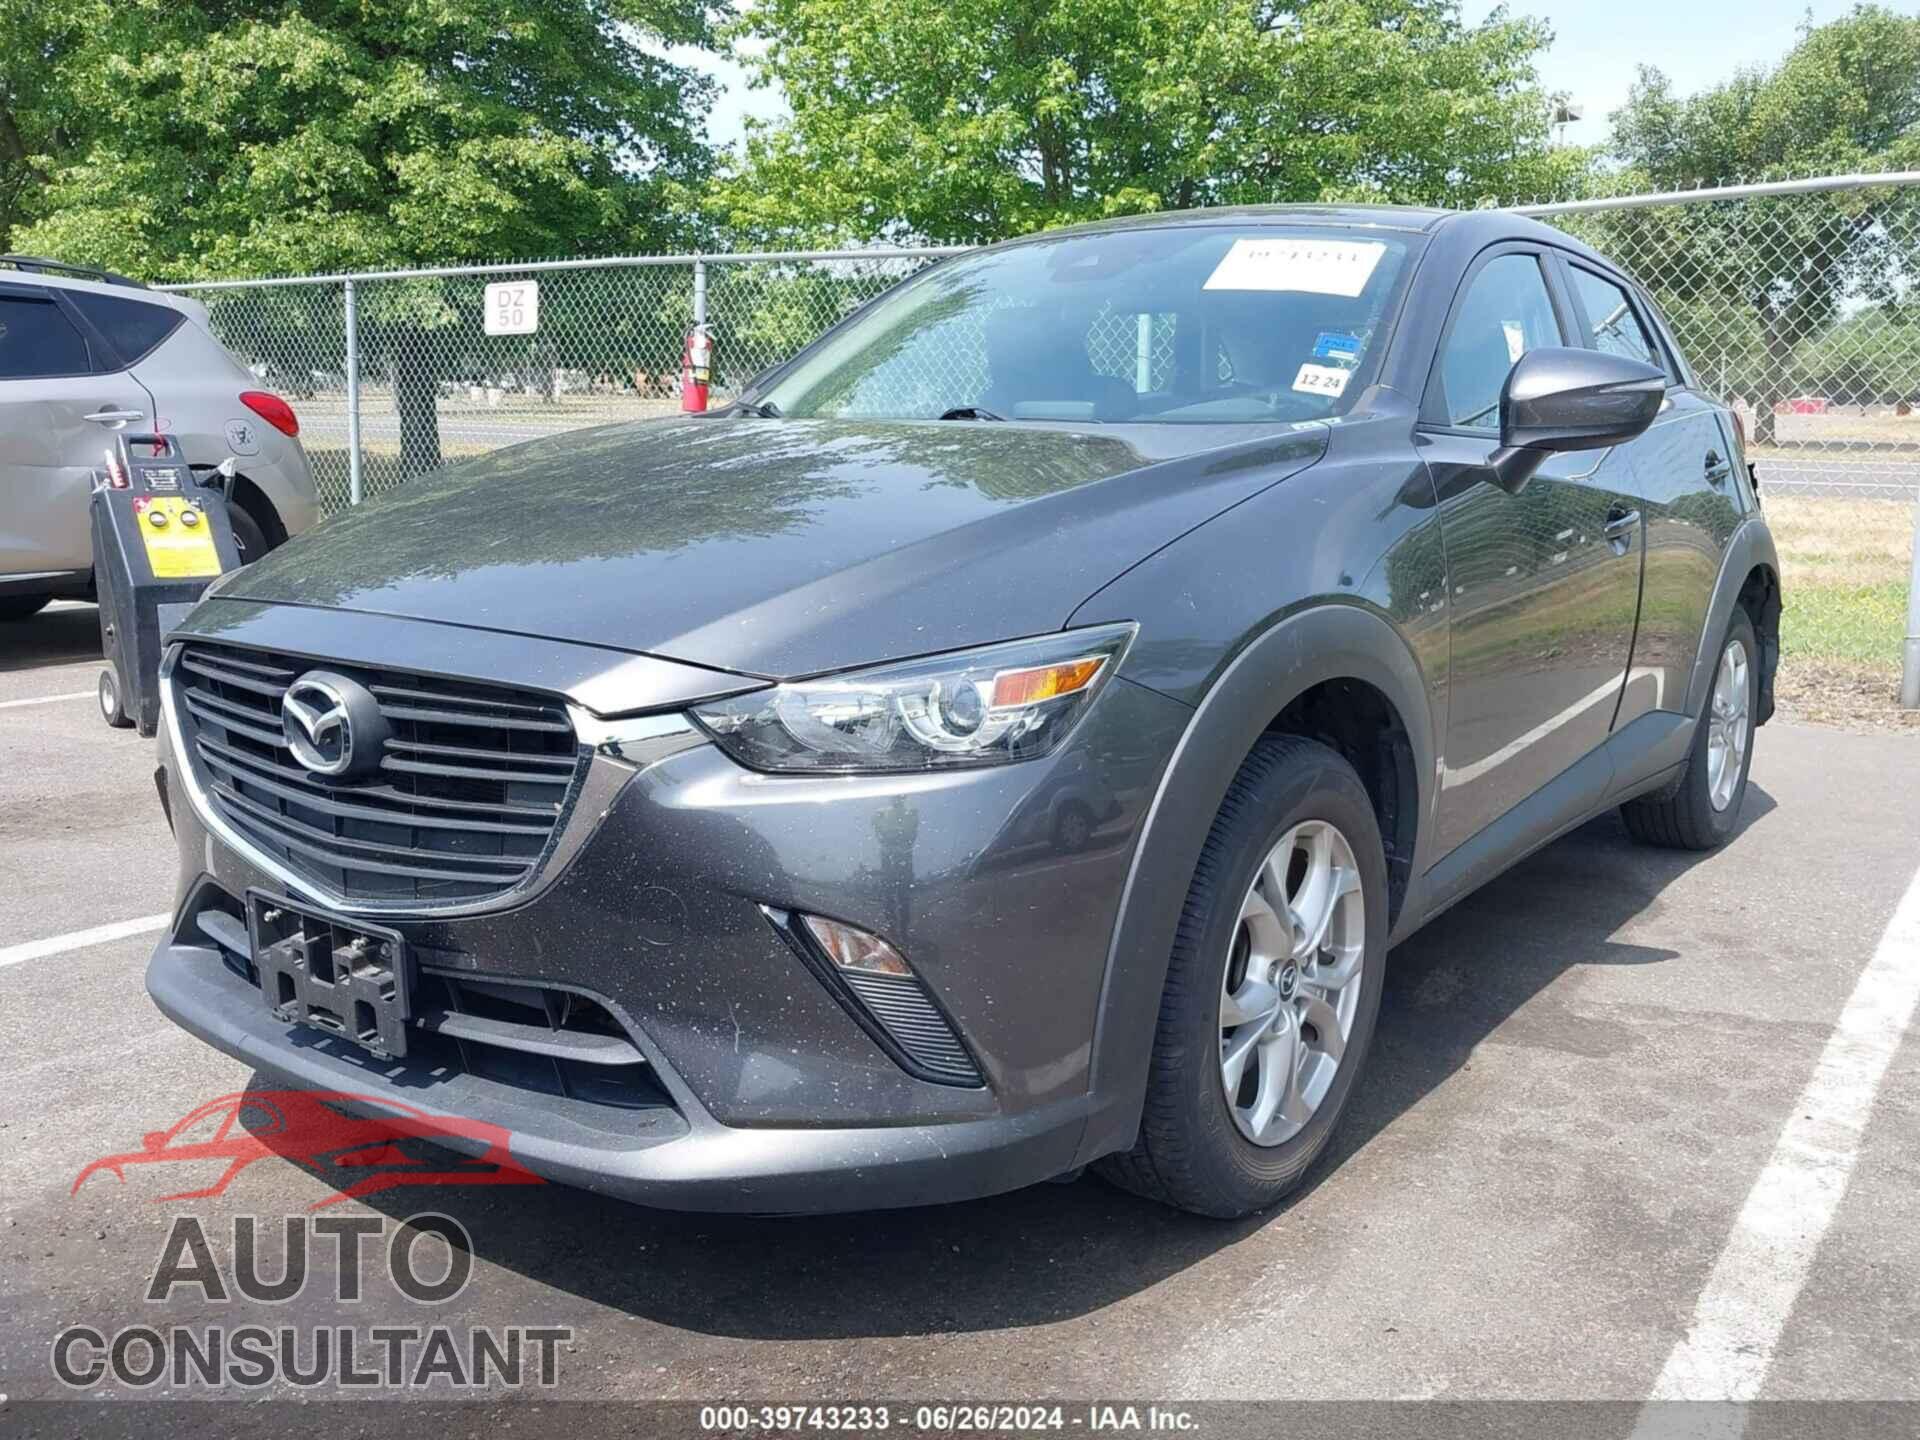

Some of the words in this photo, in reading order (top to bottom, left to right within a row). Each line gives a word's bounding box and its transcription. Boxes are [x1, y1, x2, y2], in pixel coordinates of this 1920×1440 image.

[498, 289, 525, 307] DZ
[498, 308, 524, 327] 50
[1300, 373, 1321, 386] 12
[1323, 376, 1341, 389] 24
